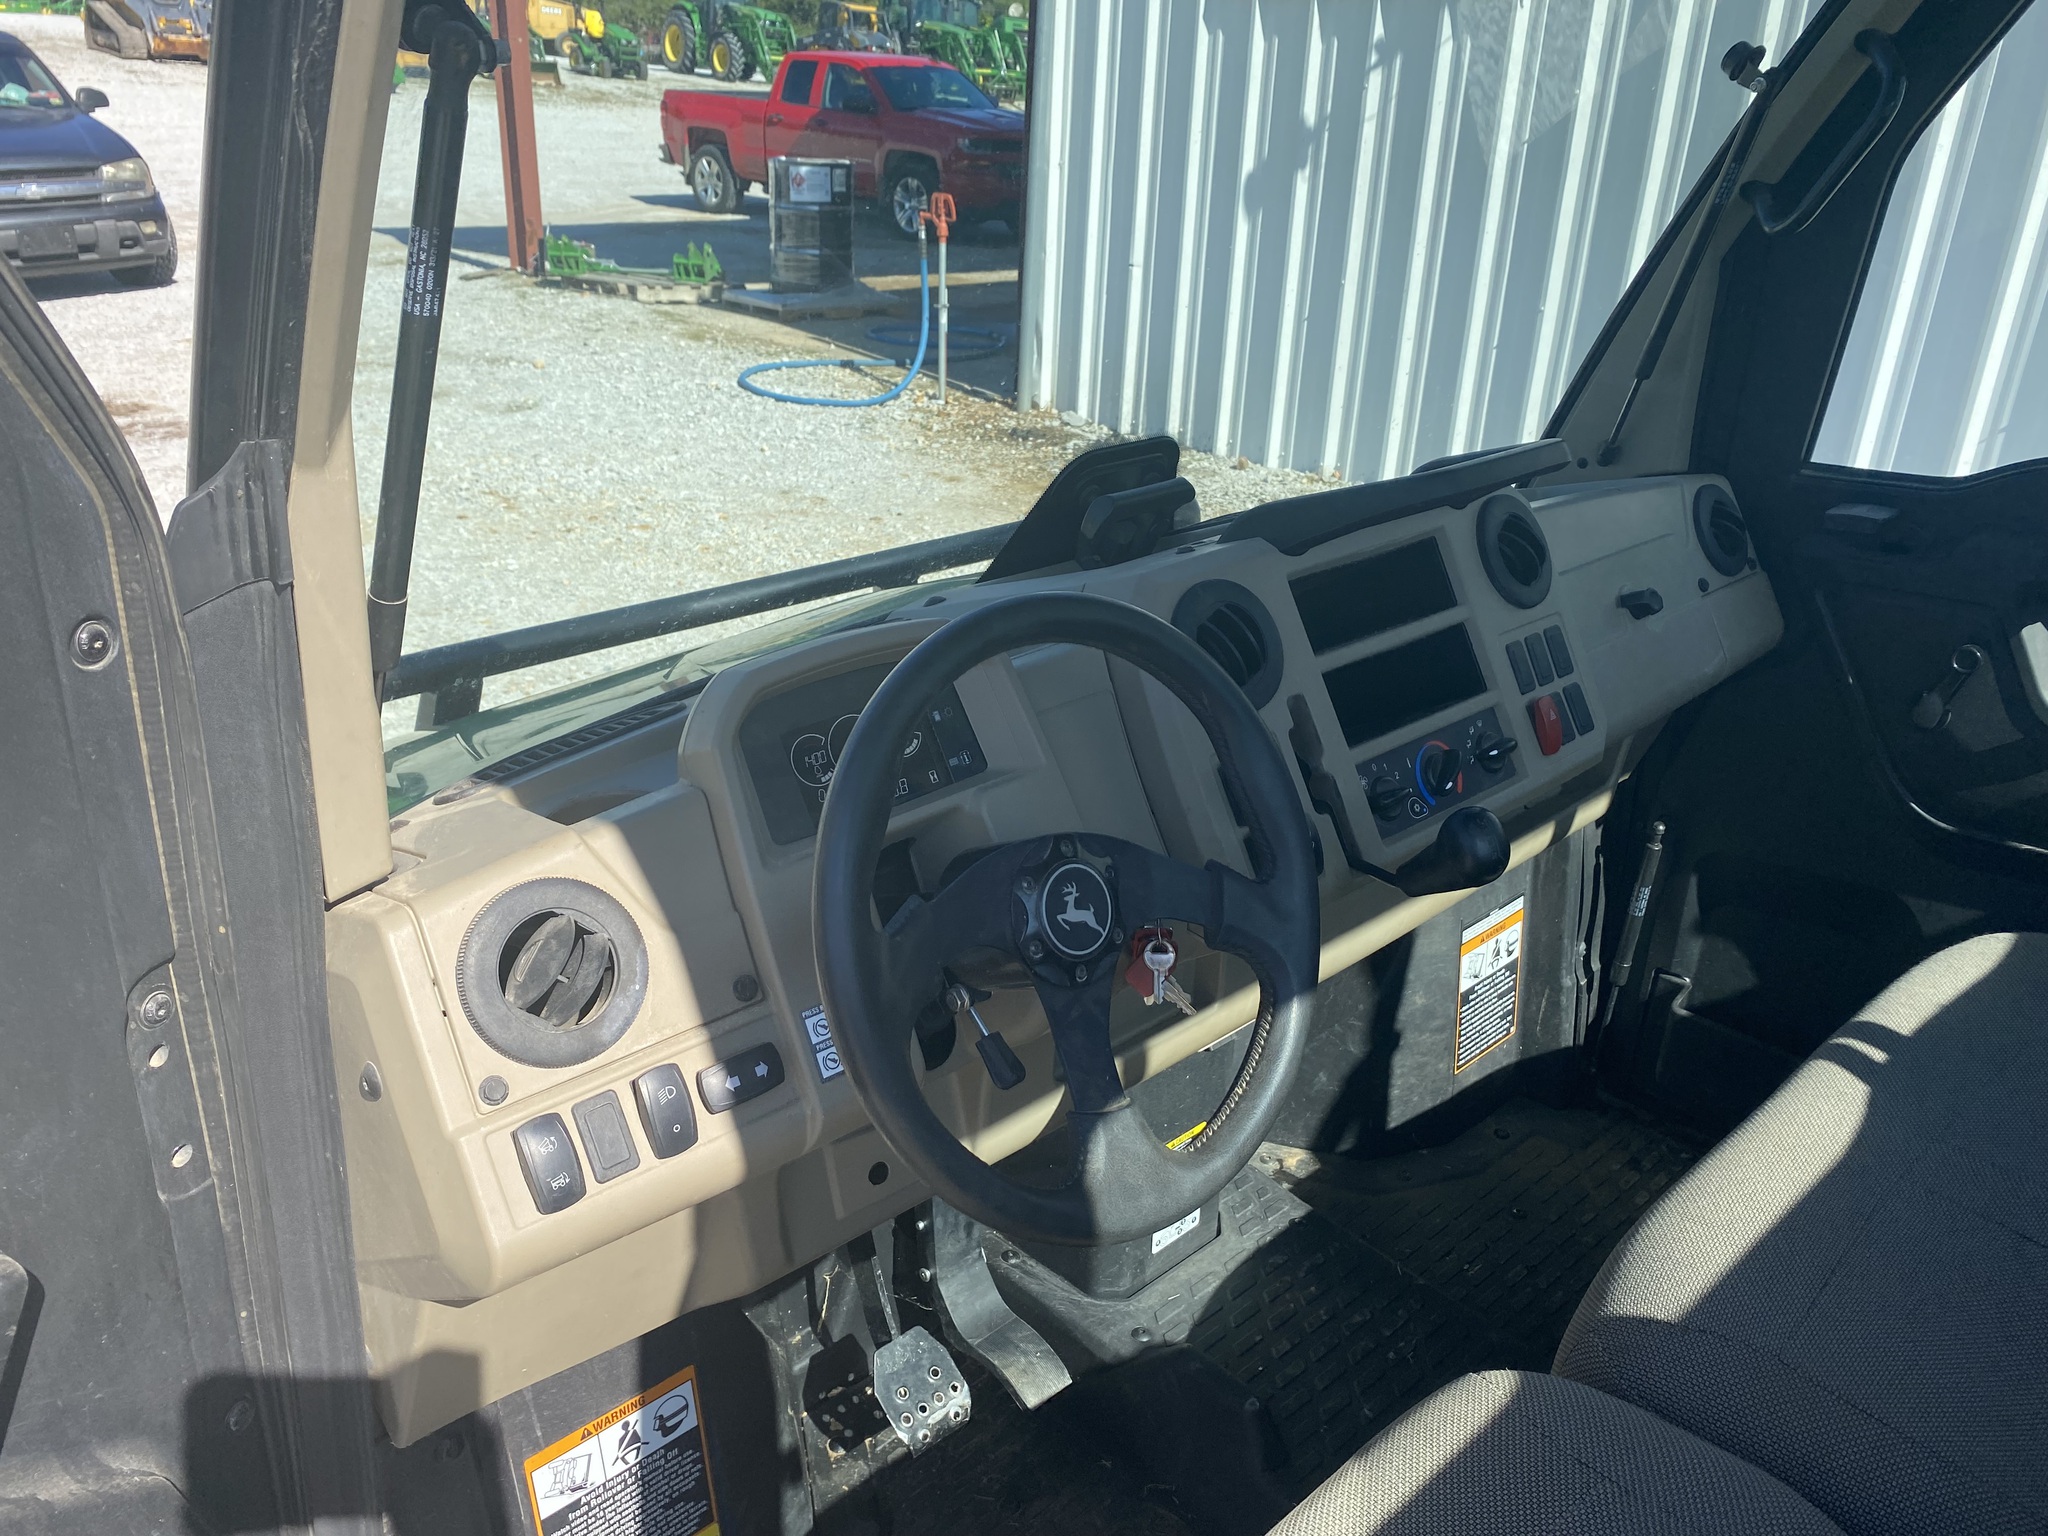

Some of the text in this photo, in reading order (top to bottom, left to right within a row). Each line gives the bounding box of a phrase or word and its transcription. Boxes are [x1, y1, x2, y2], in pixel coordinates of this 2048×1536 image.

[420, 250, 426, 260] NC
[1372, 763, 1377, 771] 0
[1394, 771, 1400, 780] 2
[802, 1006, 820, 1018] PRESS
[816, 1040, 834, 1051] PRESS
[592, 1394, 646, 1433] WARNING
[580, 1447, 665, 1505] Avoid Injury or Death
[568, 1447, 678, 1521] from Rollover or Falling Off
